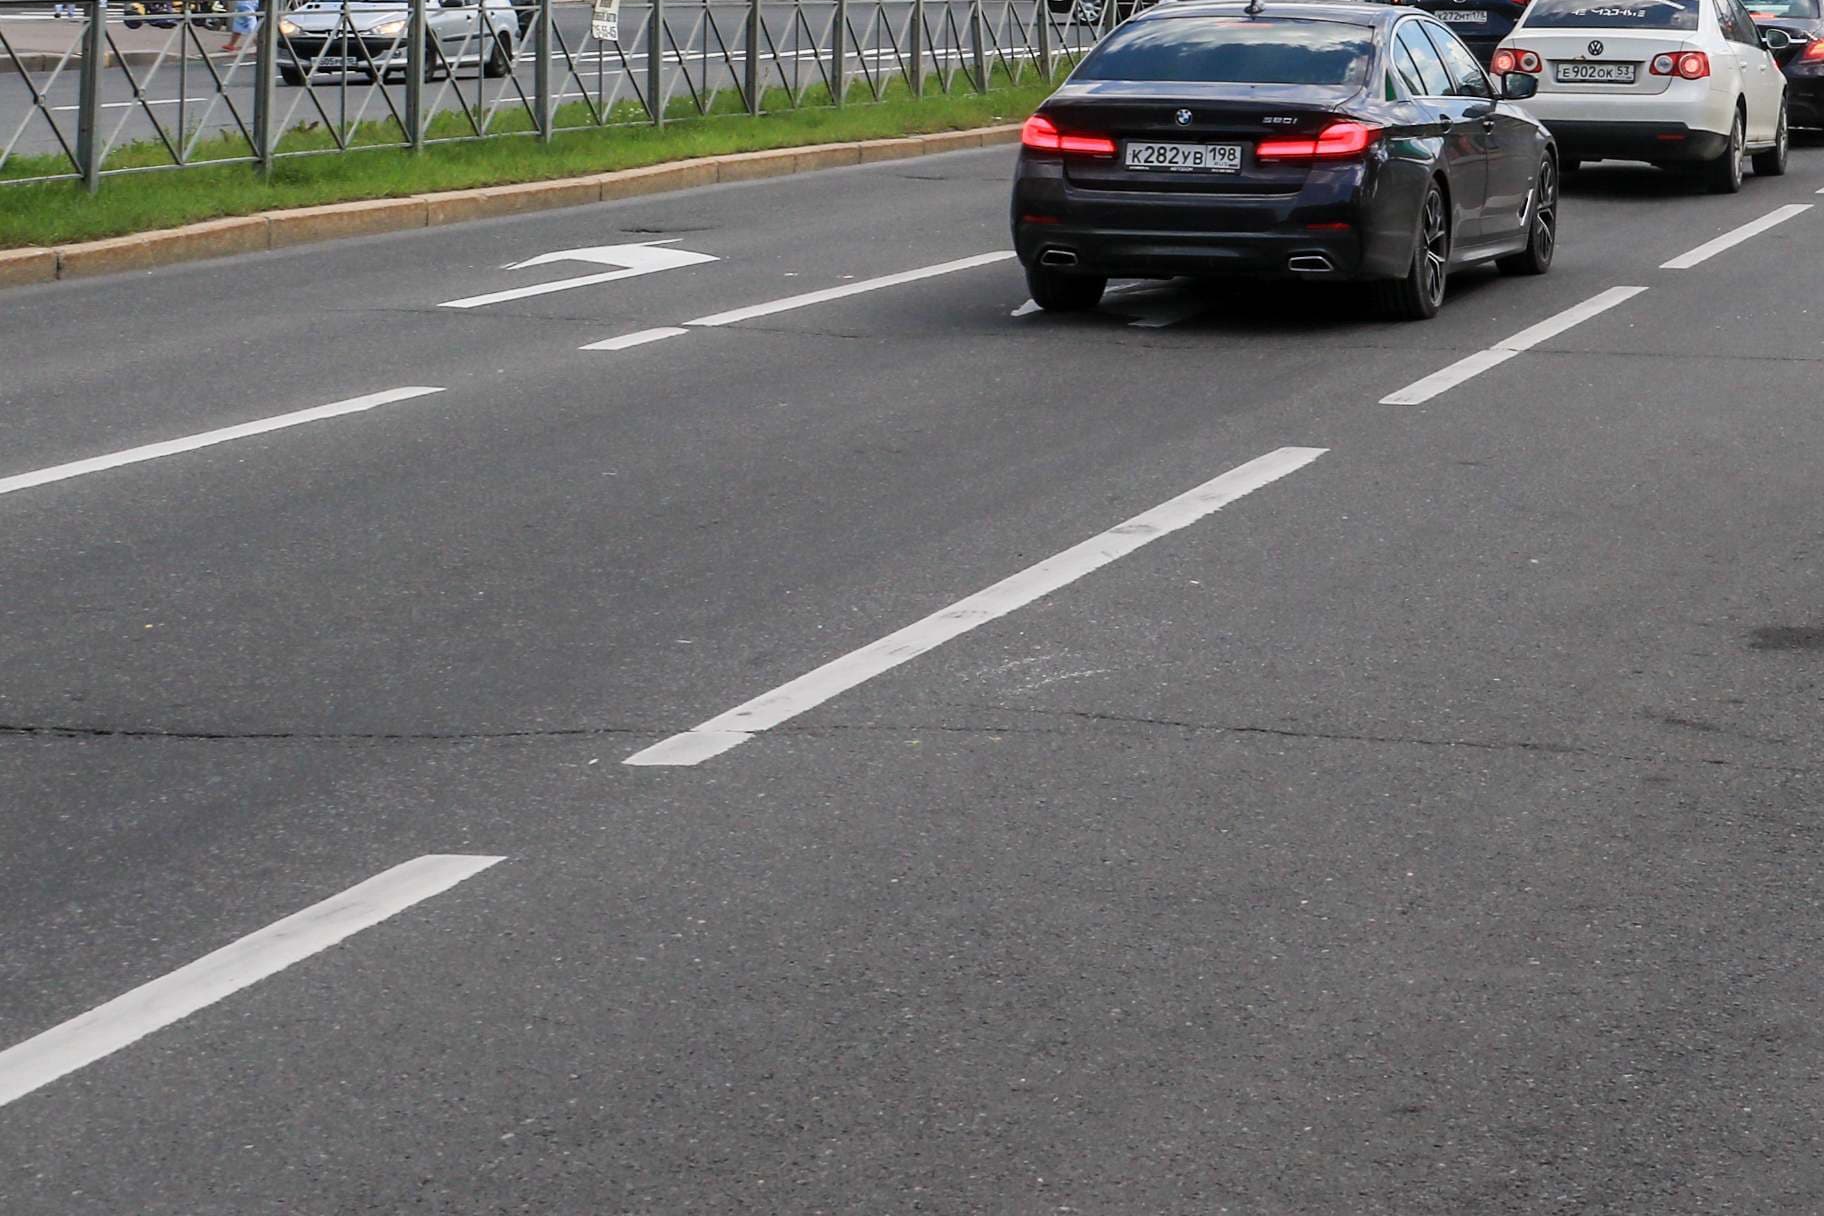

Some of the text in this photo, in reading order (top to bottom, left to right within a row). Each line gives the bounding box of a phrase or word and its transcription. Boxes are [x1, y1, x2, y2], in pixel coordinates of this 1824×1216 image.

[1562, 65, 1630, 78] Е902ОК 53
[1131, 146, 1237, 166] К282УВ 198
